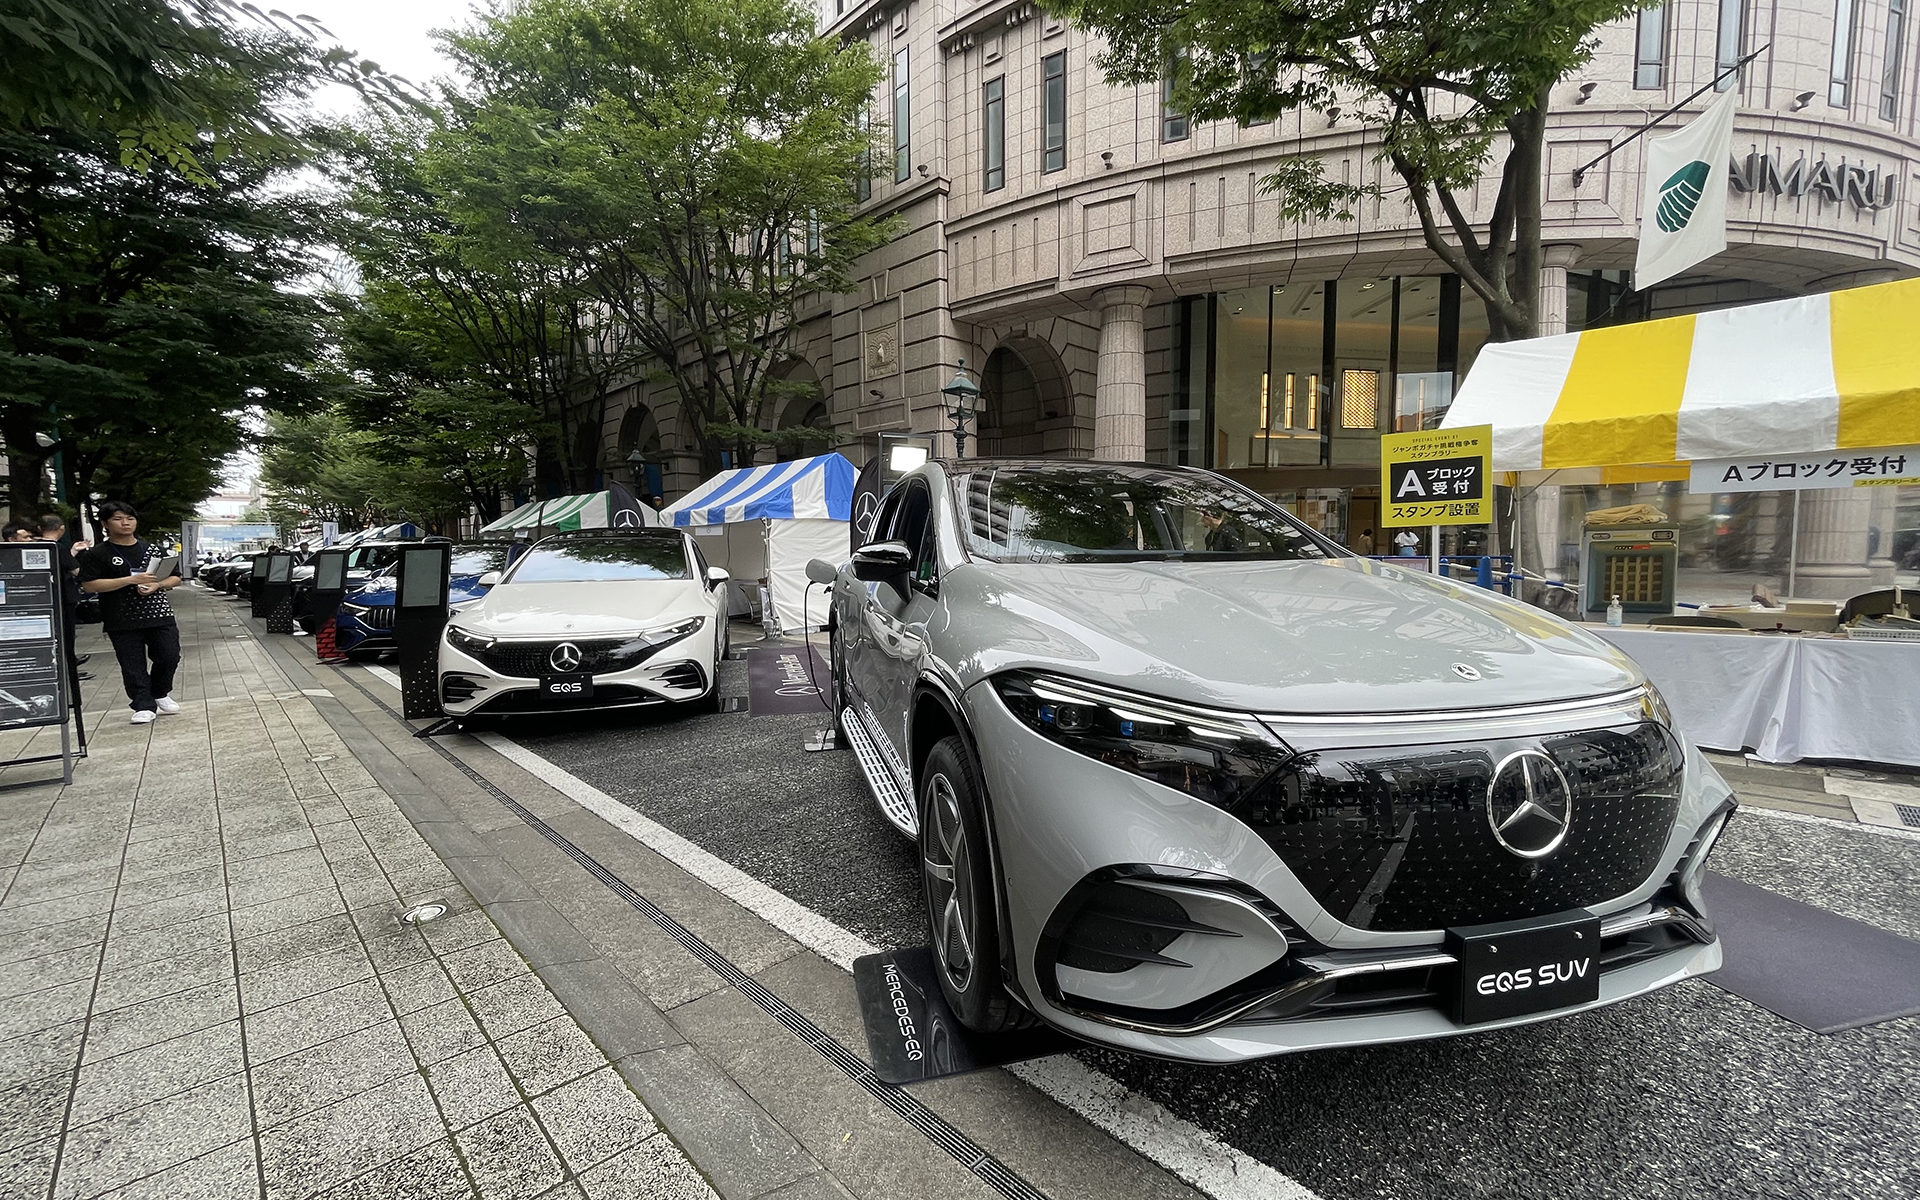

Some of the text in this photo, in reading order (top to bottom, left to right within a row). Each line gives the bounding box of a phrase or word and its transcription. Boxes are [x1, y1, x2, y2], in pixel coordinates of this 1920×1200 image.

[1410, 449, 1459, 459] スタンプラリー
[1396, 466, 1476, 498] A ブロック
[1392, 502, 1480, 519] スタンプ設置
[550, 682, 582, 693] EQS
[1476, 957, 1590, 996] EQS SUV
